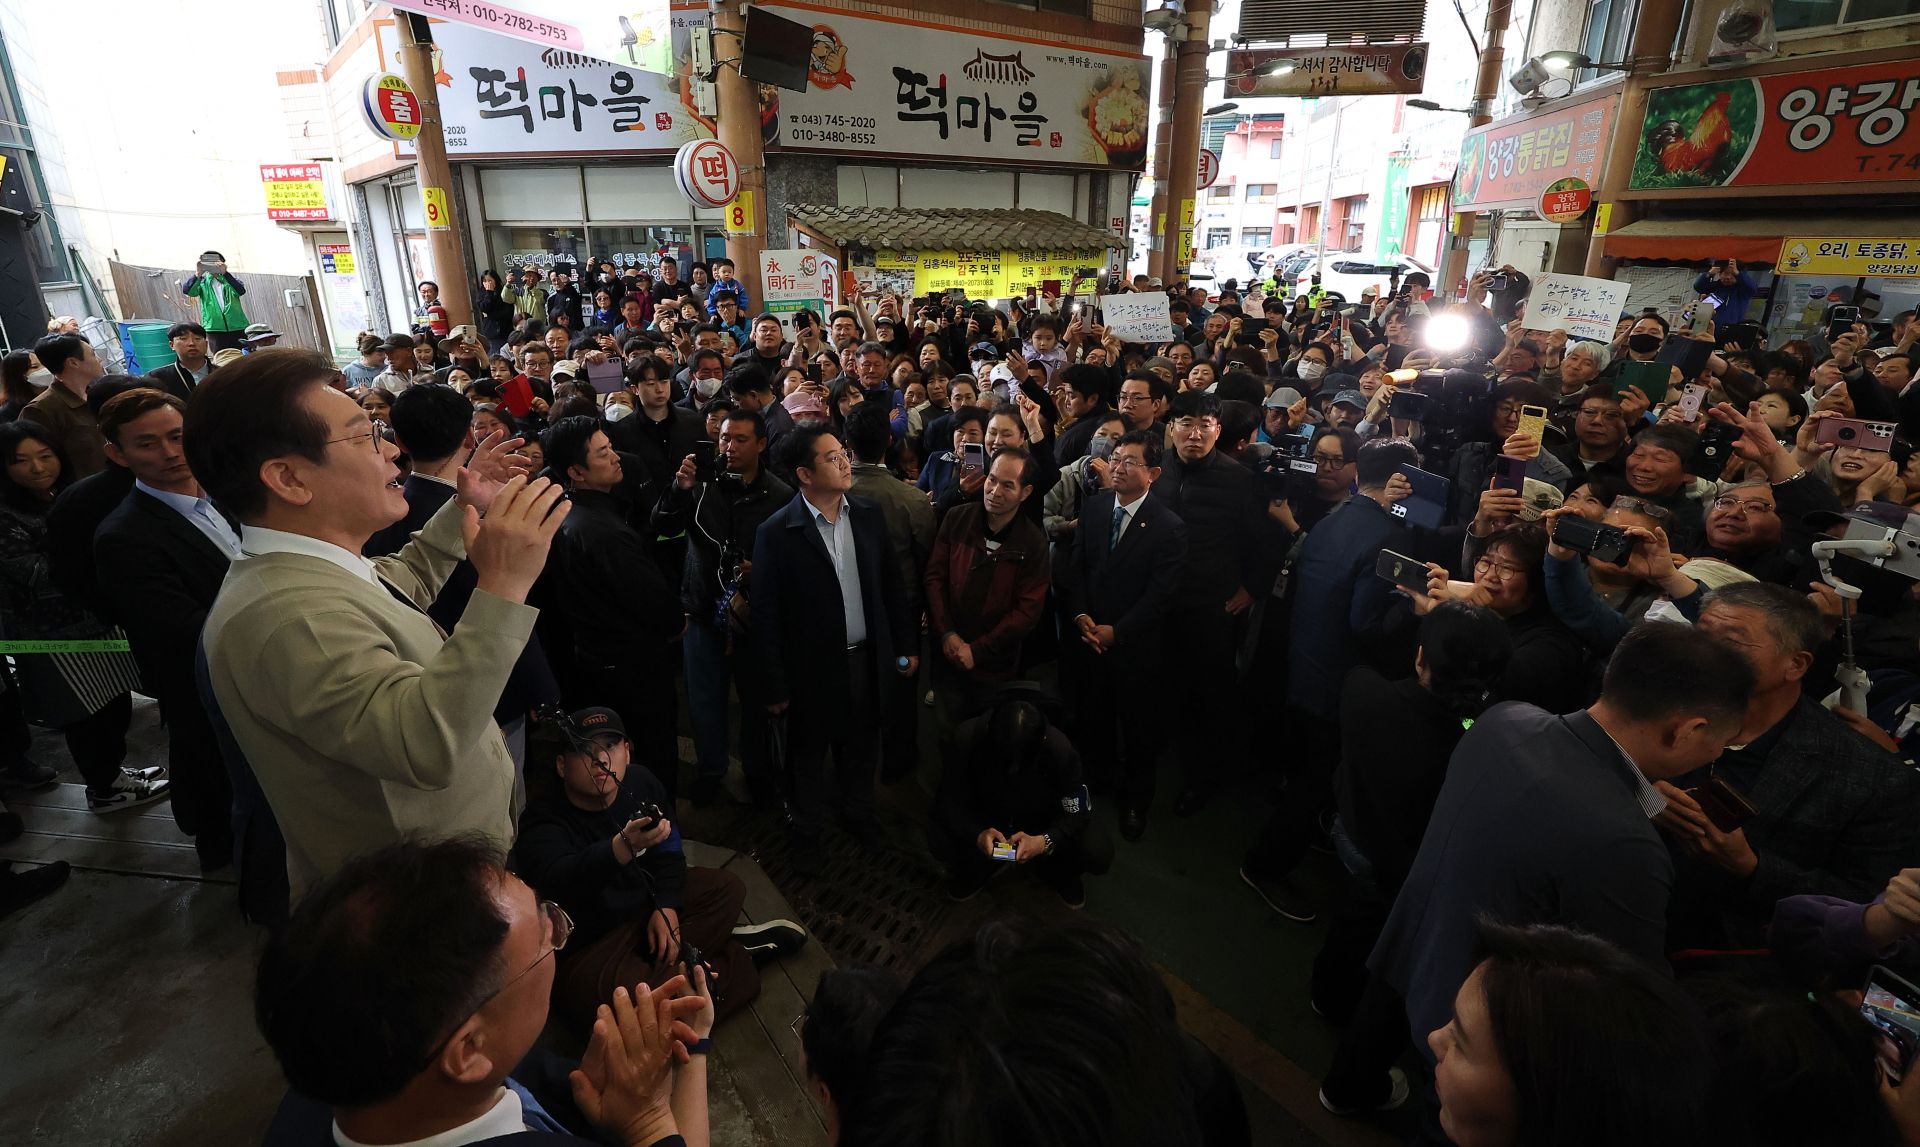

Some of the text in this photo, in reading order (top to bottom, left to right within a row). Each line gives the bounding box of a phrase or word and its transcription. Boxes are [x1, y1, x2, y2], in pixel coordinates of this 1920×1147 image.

[473, 5, 567, 41] 010-2782-5753
[1329, 54, 1391, 73] 감사합니다
[390, 91, 412, 122] 춤
[469, 66, 650, 134] 떡마을
[893, 67, 1048, 146] 떡마을
[801, 114, 876, 128] 043) 745-2020
[792, 129, 876, 144] 010-3480-8552
[1488, 119, 1575, 182] 양강통닭집
[697, 151, 730, 196] 떡
[1557, 193, 1577, 203] 양강
[427, 203, 439, 221] 9
[733, 207, 745, 226] 8
[1187, 211, 1193, 223] 7
[1594, 215, 1602, 229] 4
[1111, 217, 1125, 282] 떡을
[1815, 242, 1909, 260] 오리, 토종닭,
[766, 258, 781, 274] 永
[923, 258, 956, 269] 김홍석의
[958, 251, 1000, 263] 포도주먹떡
[1867, 264, 1918, 274] 양강닭집
[1022, 266, 1034, 277] 전국
[767, 275, 796, 290] 同行
